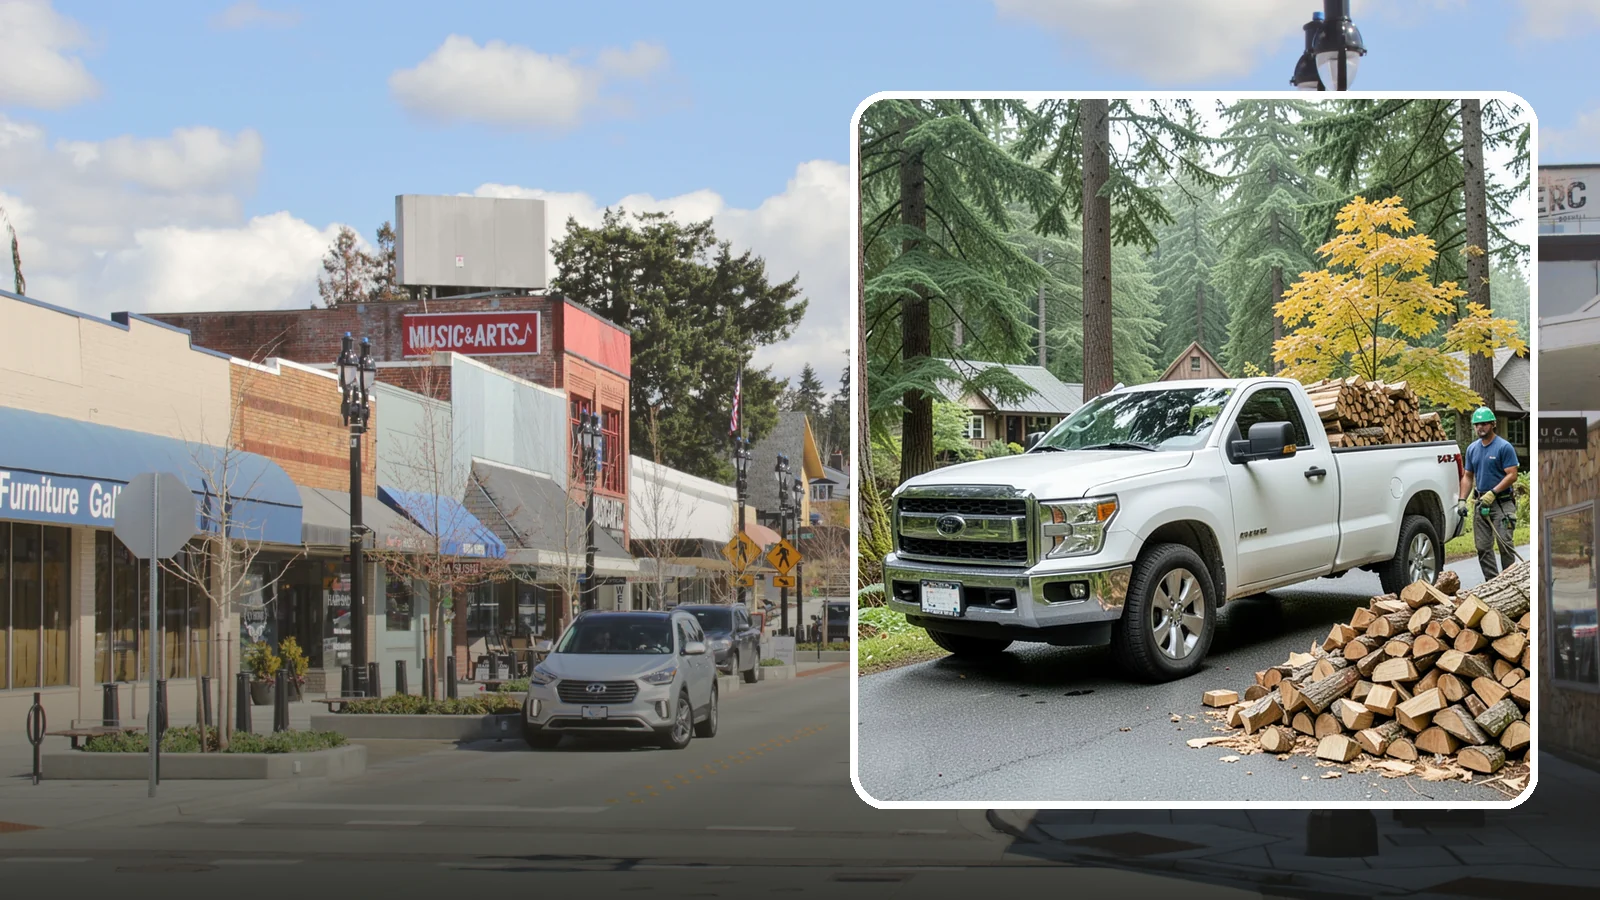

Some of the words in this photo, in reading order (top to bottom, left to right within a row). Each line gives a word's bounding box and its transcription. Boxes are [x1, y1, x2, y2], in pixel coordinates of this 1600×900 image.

[0, 471, 79, 515] Furniture
[89, 482, 122, 519] Gal
[453, 563, 479, 574] SUSHI
